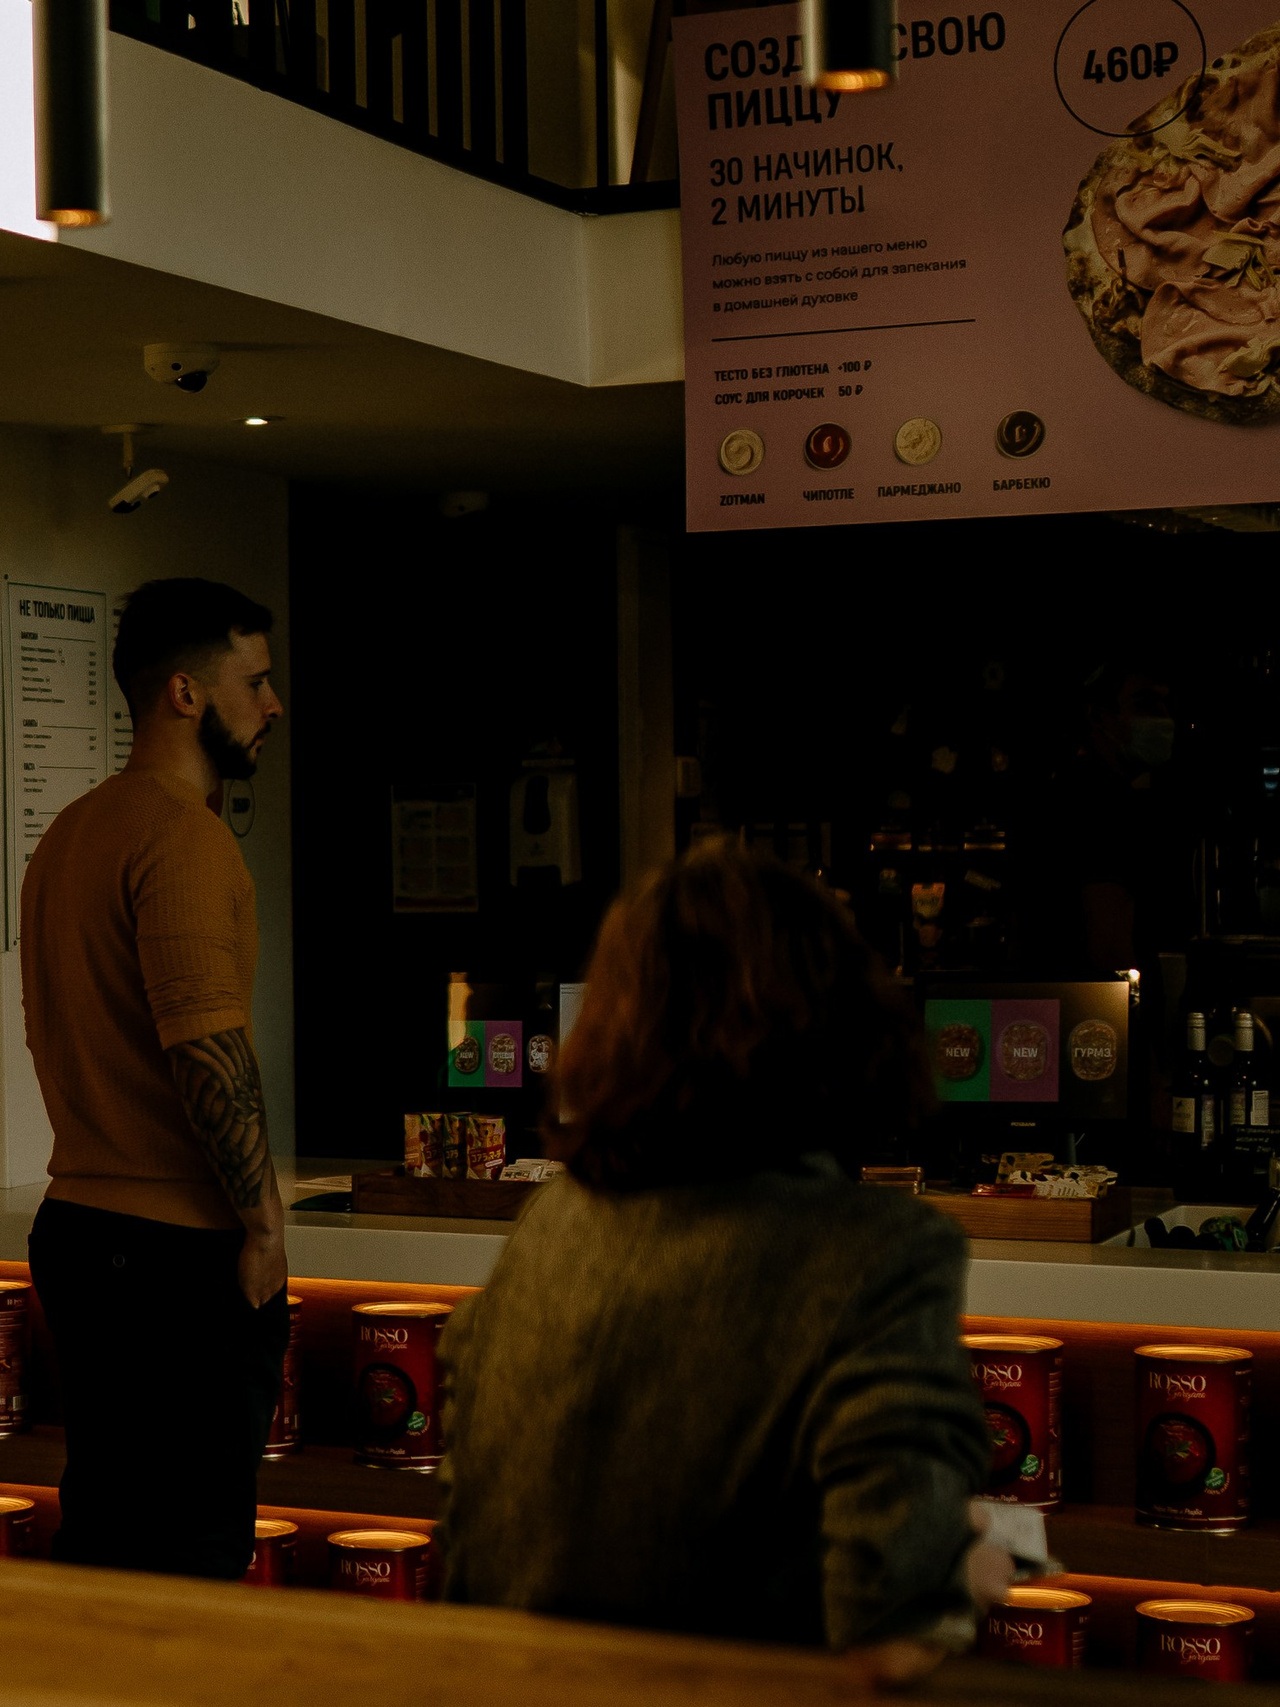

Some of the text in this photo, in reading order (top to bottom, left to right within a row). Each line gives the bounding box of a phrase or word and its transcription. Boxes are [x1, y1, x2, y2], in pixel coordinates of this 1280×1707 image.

[705, 34, 804, 81] СОЗД
[1083, 41, 1178, 83] 460₽
[708, 84, 841, 130] ПИЦЦУ
[710, 142, 903, 187] 30 НАЧИНОК,
[711, 185, 865, 225] 2 МИНУТЫ
[712, 238, 928, 268] Любую пиццу из нашего меню
[712, 258, 967, 290] можно взять с собой для запекания
[713, 290, 858, 313] в домашней духовке
[715, 369, 748, 382] ТЕСТО
[752, 367, 773, 379] БЕЗ
[776, 363, 829, 378] ГЛЮТЕНА
[715, 392, 742, 405] СОУС
[746, 391, 769, 404] ДЛЯ
[773, 387, 825, 401] КОРОЧЕК
[838, 386, 852, 397] 50
[803, 488, 854, 502] ЧИПОТЛЕ
[878, 482, 961, 499] ПАРМЕДЖАНО
[993, 477, 1051, 492] БАРБЕКЮ
[720, 494, 765, 506] ZOTMAN
[20, 600, 95, 623] НЕ ТОЛЬКО ПИЦЦА
[946, 1047, 970, 1058] NEW
[1013, 1047, 1038, 1058] NEW
[361, 1325, 409, 1345] ROSSO
[1149, 1371, 1207, 1394] ROSSO
[340, 1558, 391, 1580] ROSSO
[988, 1617, 1043, 1641] ROSSO
[1160, 1633, 1221, 1656] ROSSO
